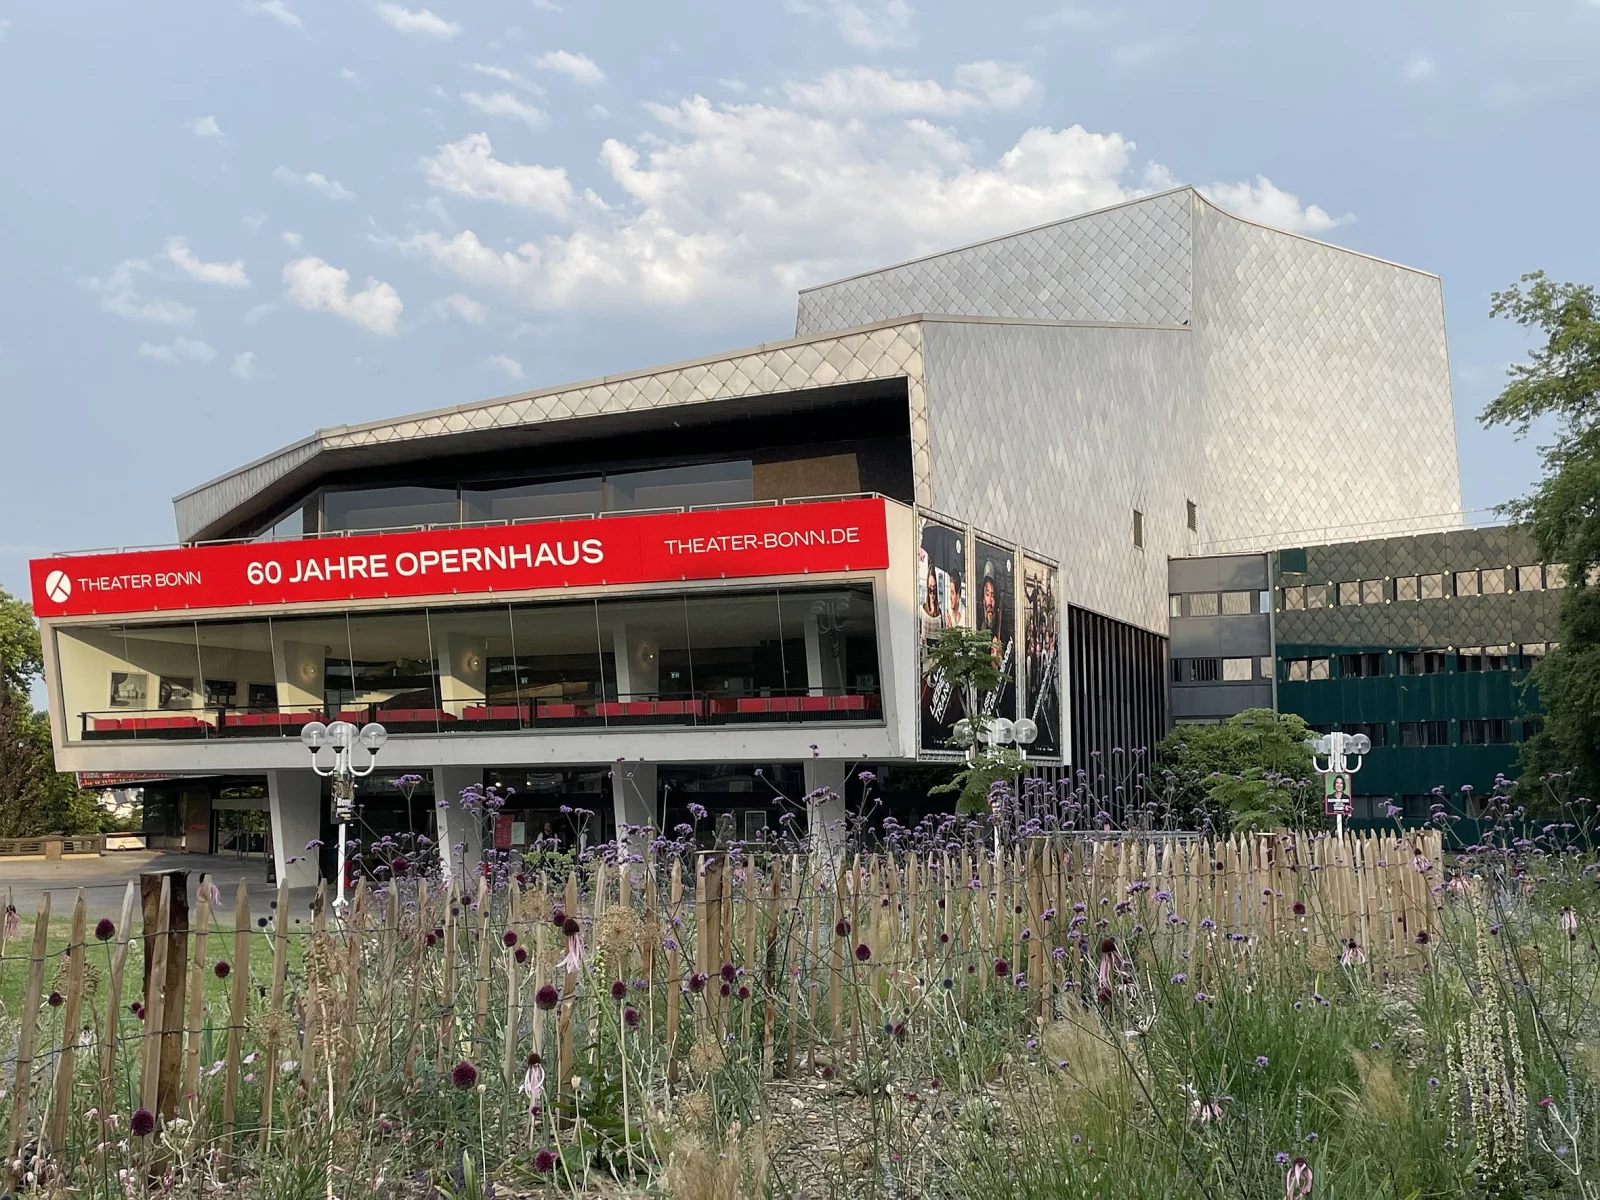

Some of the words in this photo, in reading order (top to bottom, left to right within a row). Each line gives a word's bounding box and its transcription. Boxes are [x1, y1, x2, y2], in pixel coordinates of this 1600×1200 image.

[664, 527, 860, 555] THEATER-BONN.DE
[247, 560, 282, 585] 60
[289, 554, 389, 583] JAHRE
[395, 539, 604, 577] OPERNHAUS
[77, 574, 152, 592] THEATER
[155, 571, 202, 587] BONN
